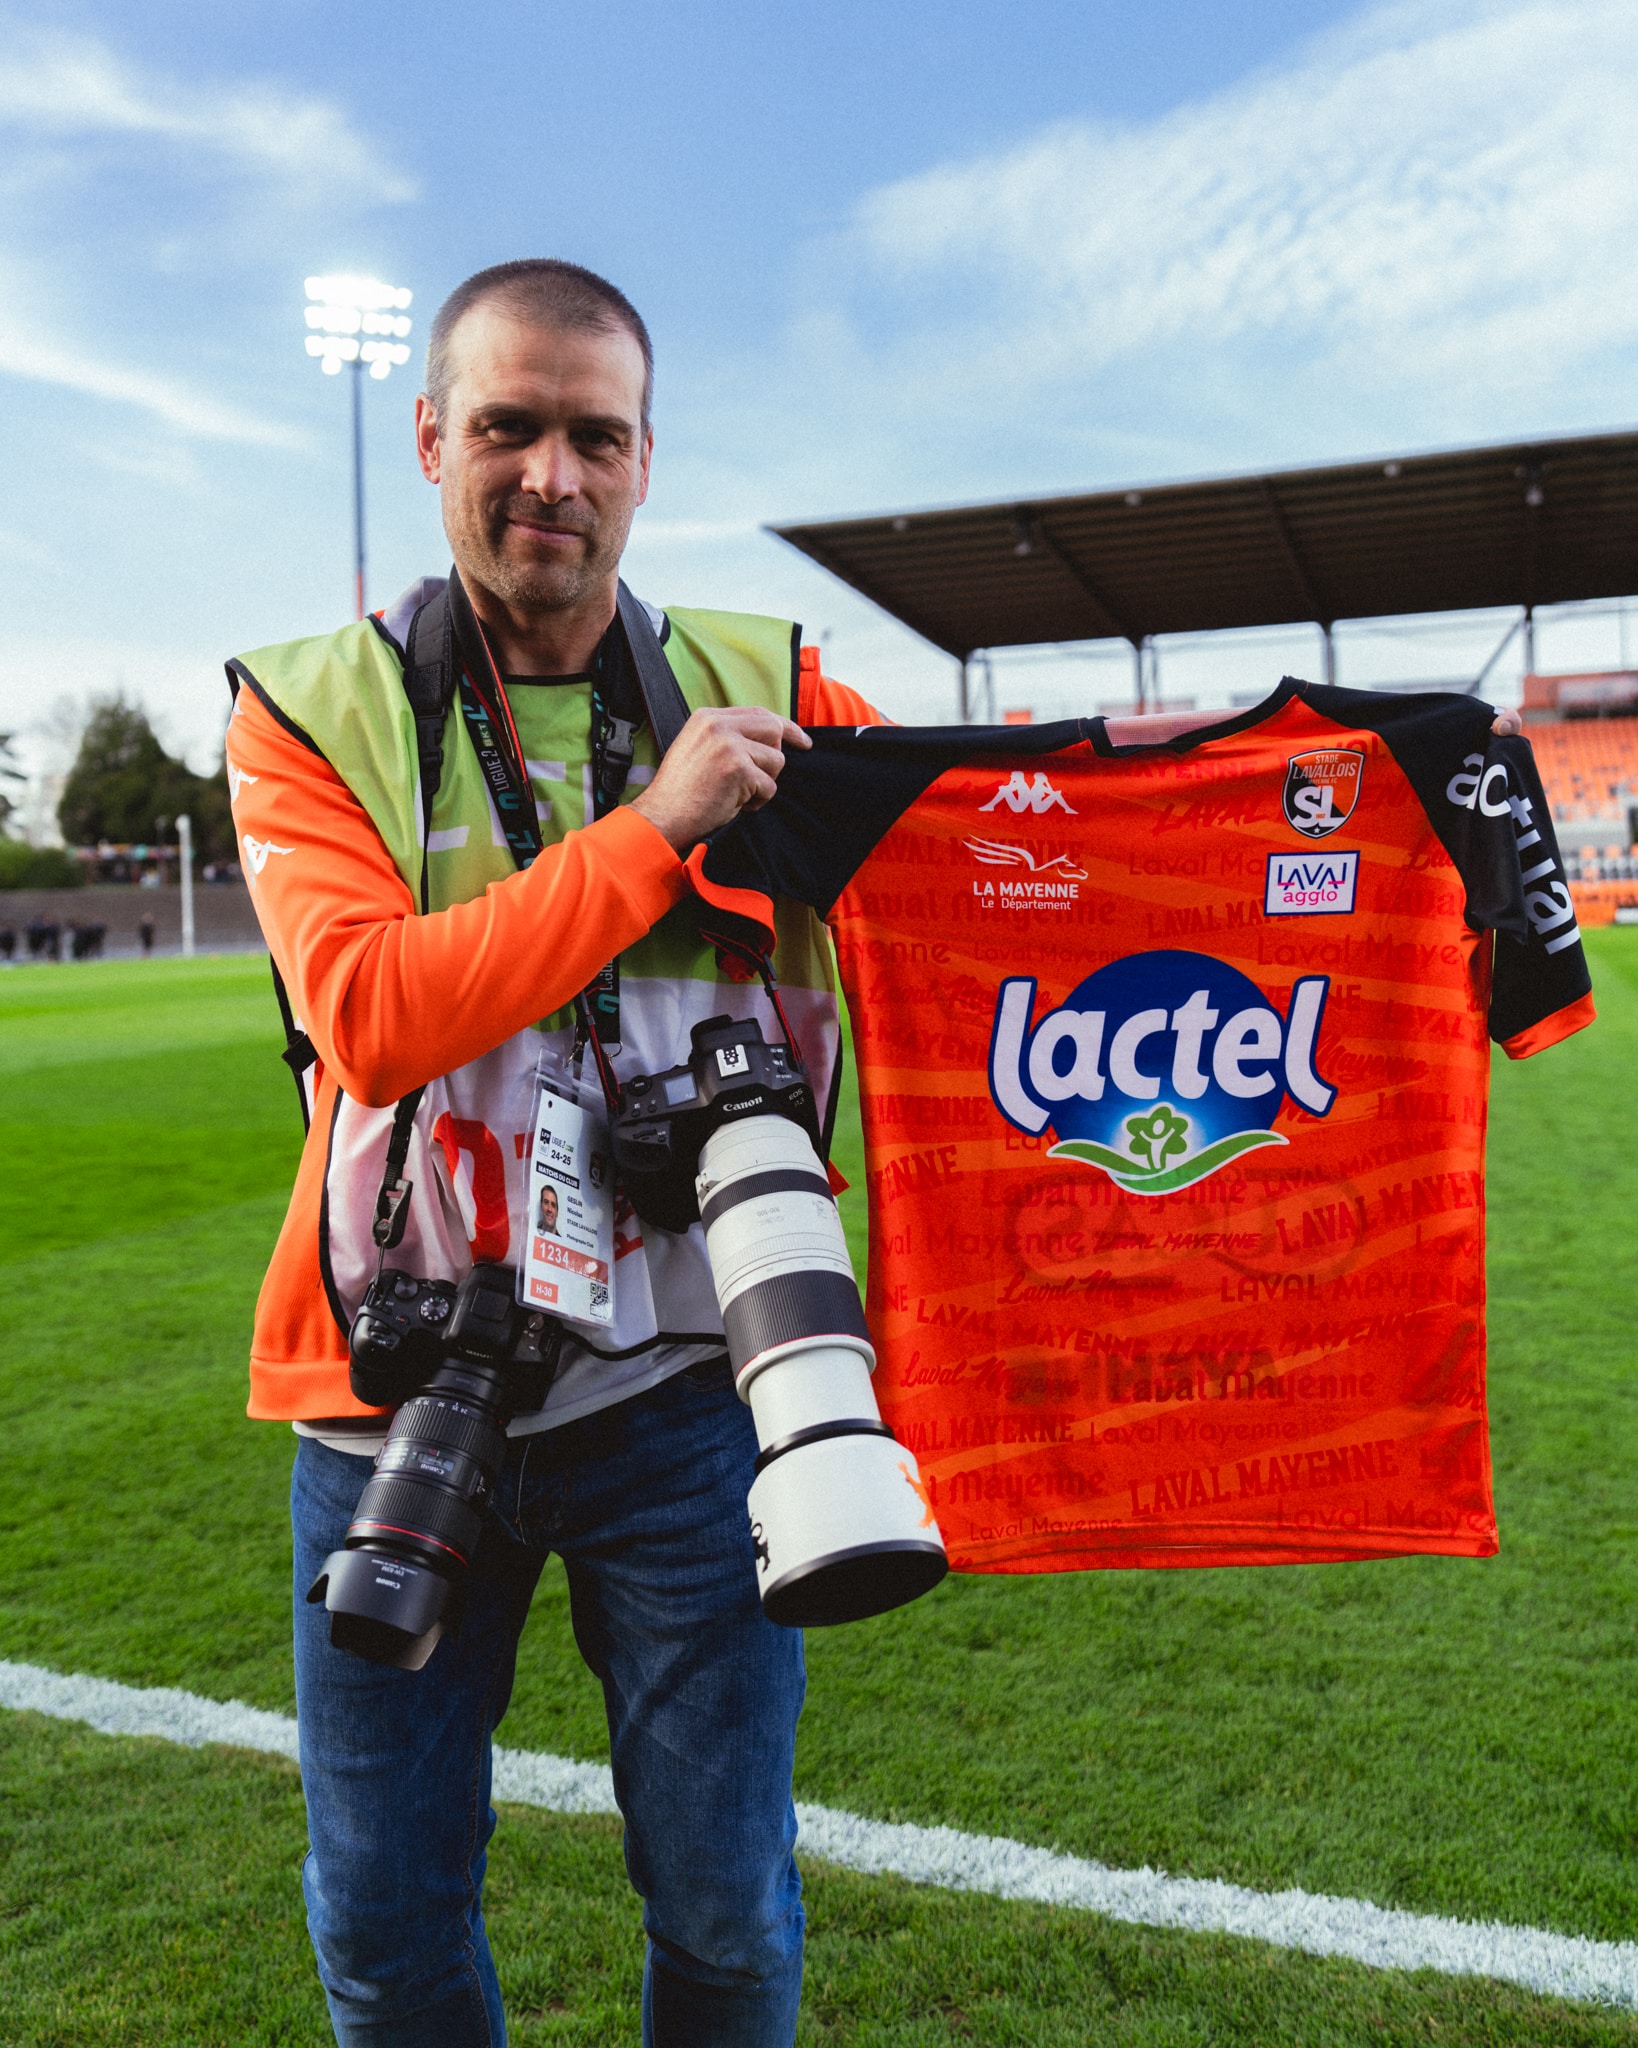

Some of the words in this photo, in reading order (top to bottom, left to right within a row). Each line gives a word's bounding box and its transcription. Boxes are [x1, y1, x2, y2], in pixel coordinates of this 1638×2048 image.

[481, 749, 498, 759] 2
[1315, 754, 1340, 764] STADE
[487, 757, 510, 791] LIGUE
[1292, 762, 1357, 780] LAVALLOIS
[1276, 861, 1348, 891] LAVAL
[973, 881, 995, 897] LA
[1000, 882, 1079, 899] MAYENNE
[1282, 889, 1338, 914] agglo
[981, 898, 995, 909] Le
[1001, 897, 1072, 911] Département
[1258, 934, 1351, 966] Laval
[990, 978, 1336, 1135] lactel
[722, 1095, 763, 1112] Canon
[788, 1088, 804, 1101] EOS
[551, 1149, 571, 1166] 24-25
[538, 1164, 559, 1180] MATCHS
[565, 1176, 578, 1188] CLUB
[981, 1176, 1077, 1208] Laval
[1276, 1196, 1377, 1255] LAVAL
[540, 1242, 569, 1267] 1234
[926, 1227, 1085, 1260] Mayenne
[536, 1284, 552, 1297] H-30
[1221, 1273, 1323, 1302] LAVAL
[917, 1298, 999, 1338] LAVAL
[1012, 1320, 1150, 1360] MAYENNE
[899, 1351, 968, 1388] Laval
[947, 1414, 1076, 1450] MAYENNE
[1090, 1421, 1163, 1446] Laval
[1175, 1416, 1299, 1449] Mayenne
[420, 1463, 445, 1475] Canon
[1130, 1464, 1231, 1517] LAVAL
[1237, 1438, 1398, 1499] MAYENNE
[1277, 1499, 1371, 1531] Laval
[970, 1519, 1024, 1542] Laval
[1032, 1516, 1123, 1538] Mayenne
[375, 1577, 401, 1590] Canon
